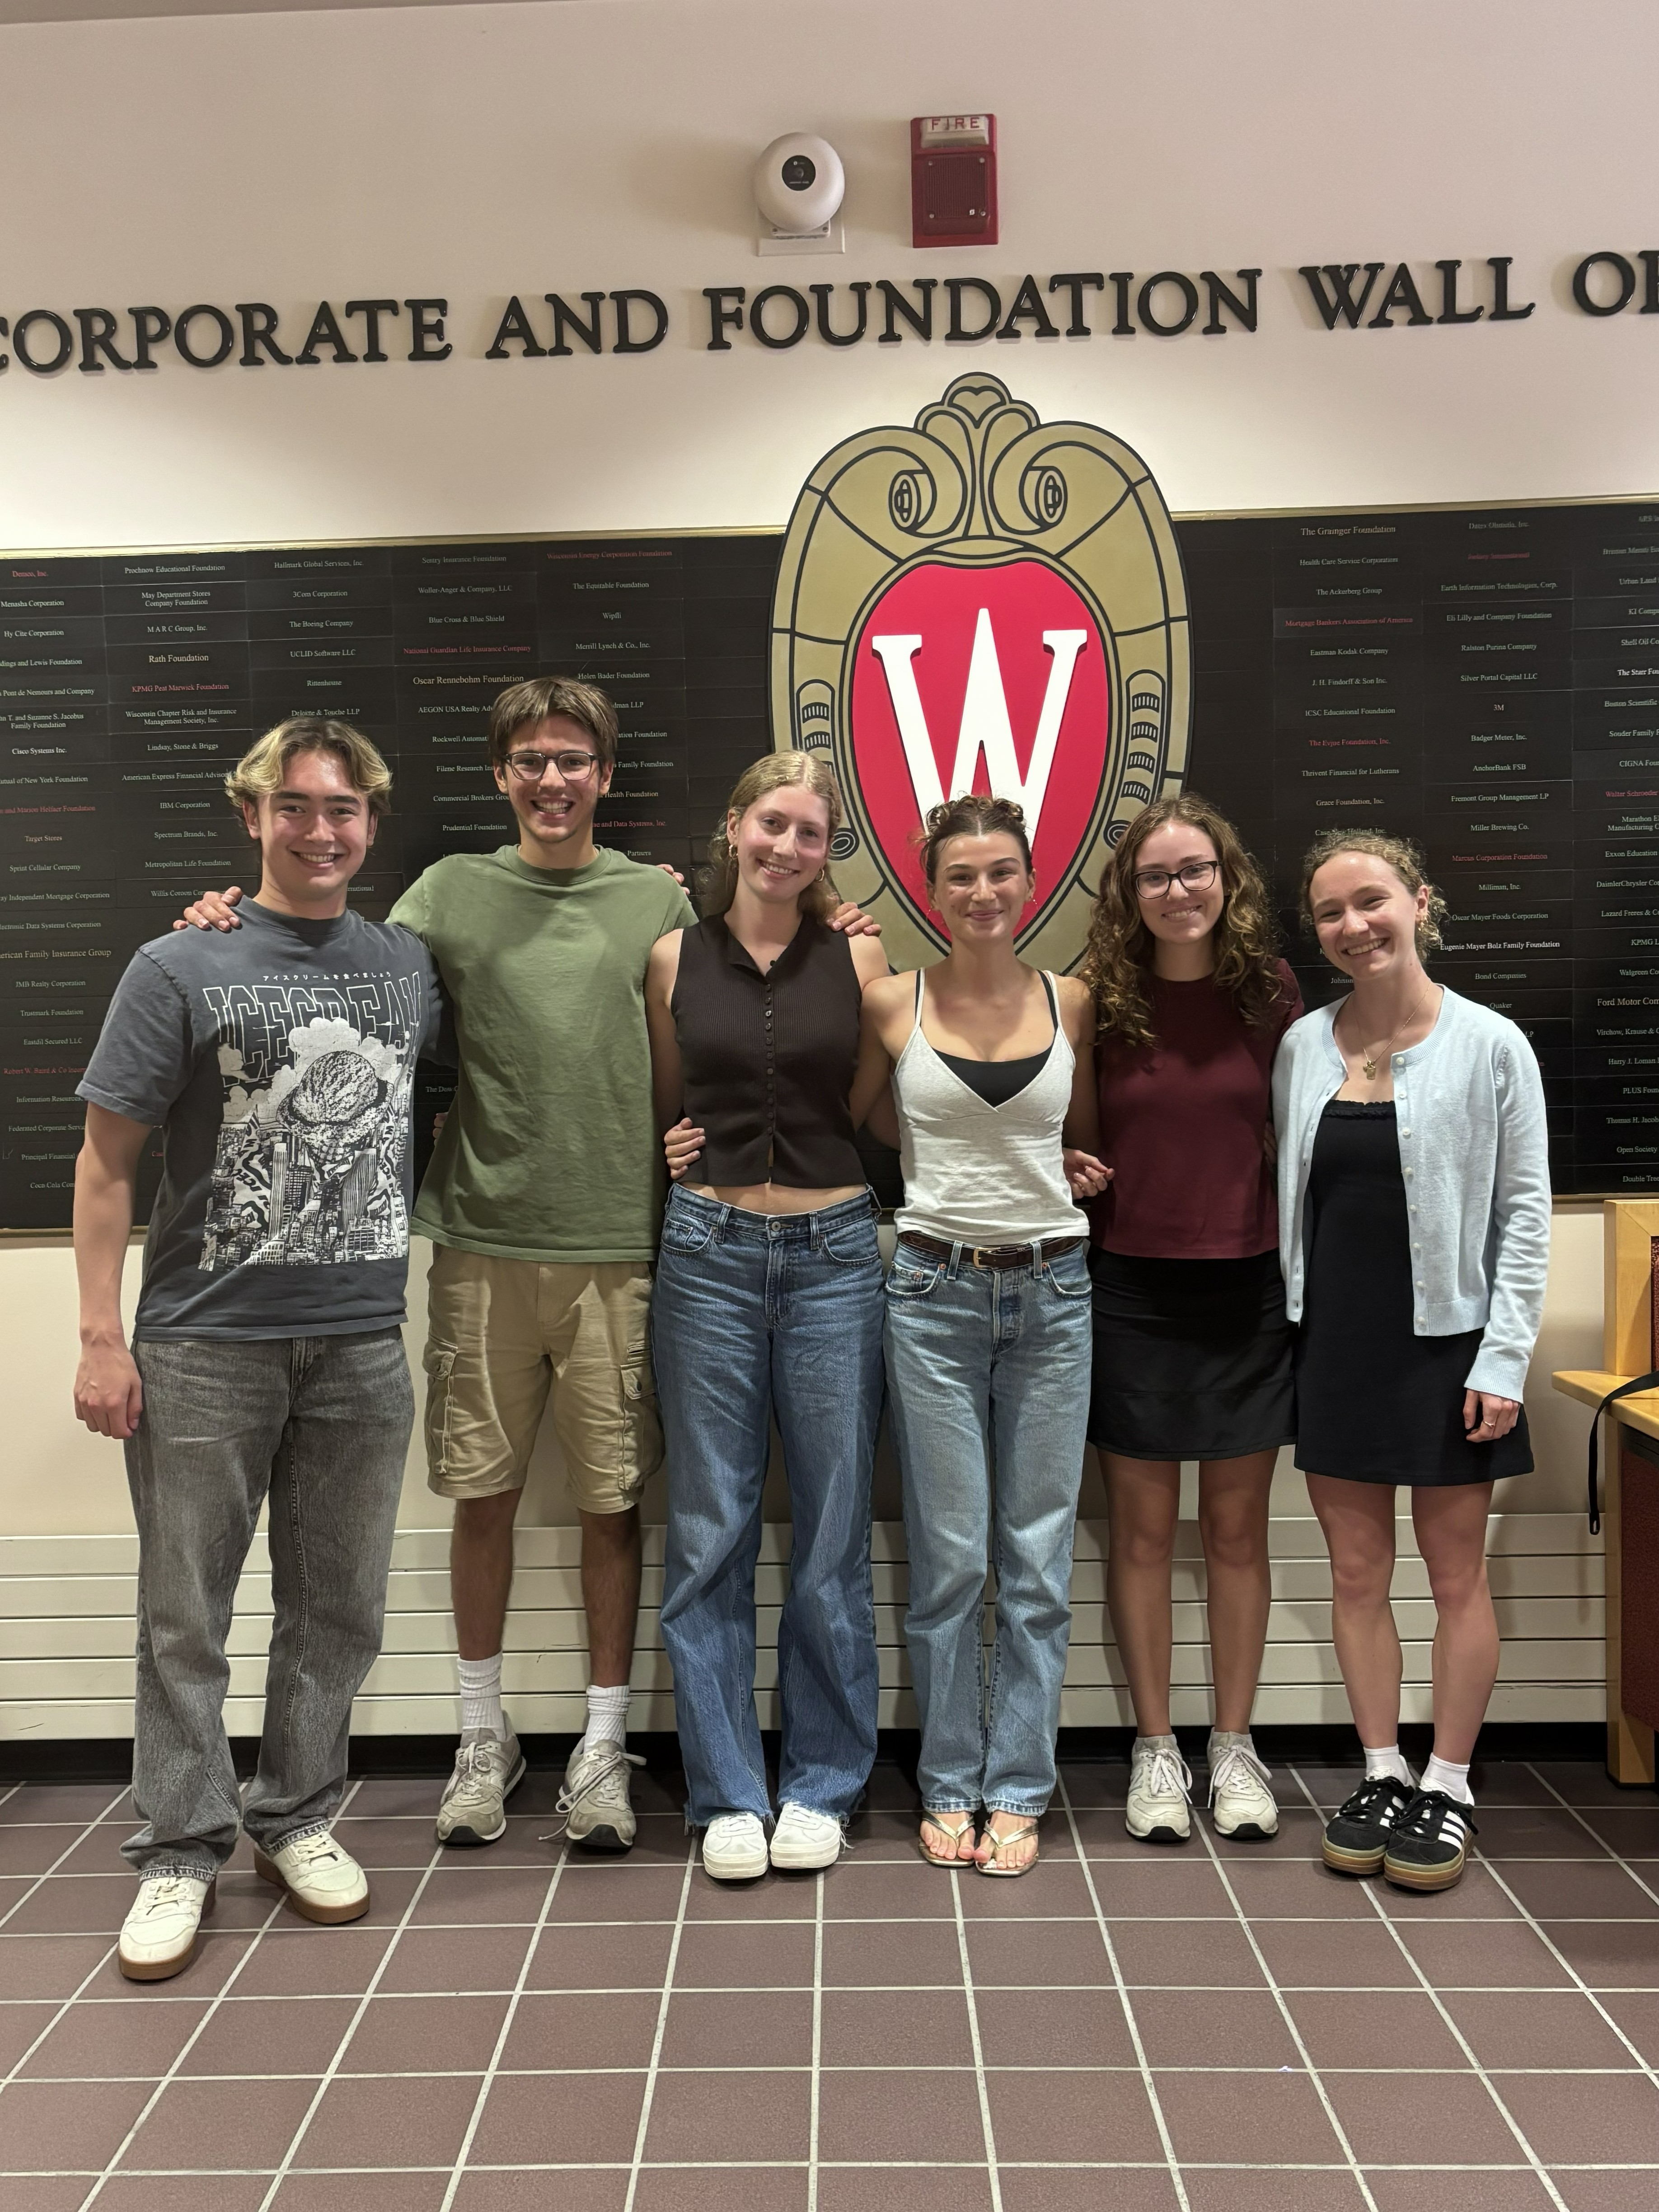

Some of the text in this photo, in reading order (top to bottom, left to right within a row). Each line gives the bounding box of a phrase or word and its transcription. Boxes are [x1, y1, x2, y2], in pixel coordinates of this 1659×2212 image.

[932, 117, 979, 130] FIRE
[0, 299, 452, 373] ORPORATE
[485, 290, 668, 359] AND
[703, 269, 1262, 350] FOUNDATION
[1298, 257, 1535, 330] WALL
[437, 675, 480, 684] Rennebohm
[872, 609, 1087, 853] W
[25, 950, 49, 959] Family
[89, 949, 111, 958] Group
[1617, 998, 1641, 1006] Motor
